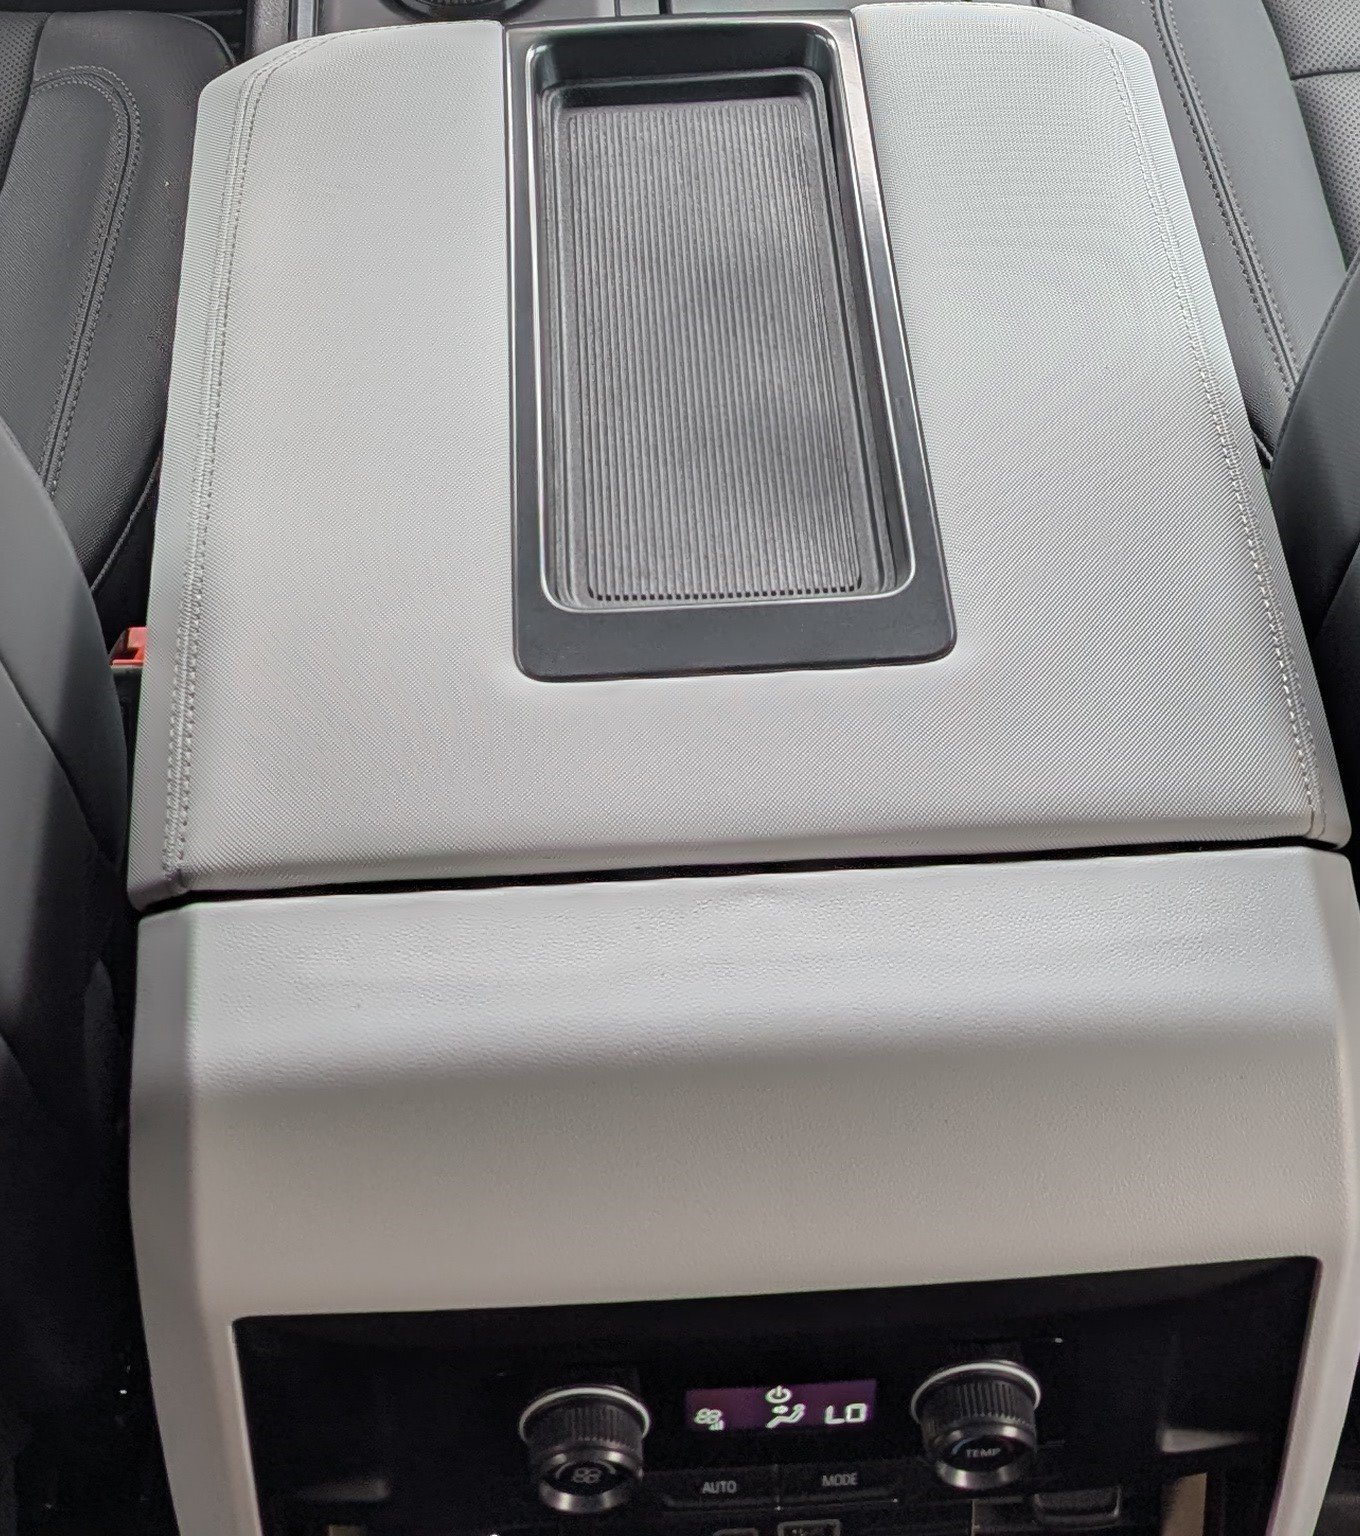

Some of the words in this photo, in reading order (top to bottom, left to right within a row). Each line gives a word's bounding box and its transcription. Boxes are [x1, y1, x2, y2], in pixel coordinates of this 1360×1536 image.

[823, 1402, 869, 1426] LO
[965, 1447, 1002, 1459] TEMP
[701, 1480, 738, 1495] AUTO
[821, 1472, 858, 1488] MODE
